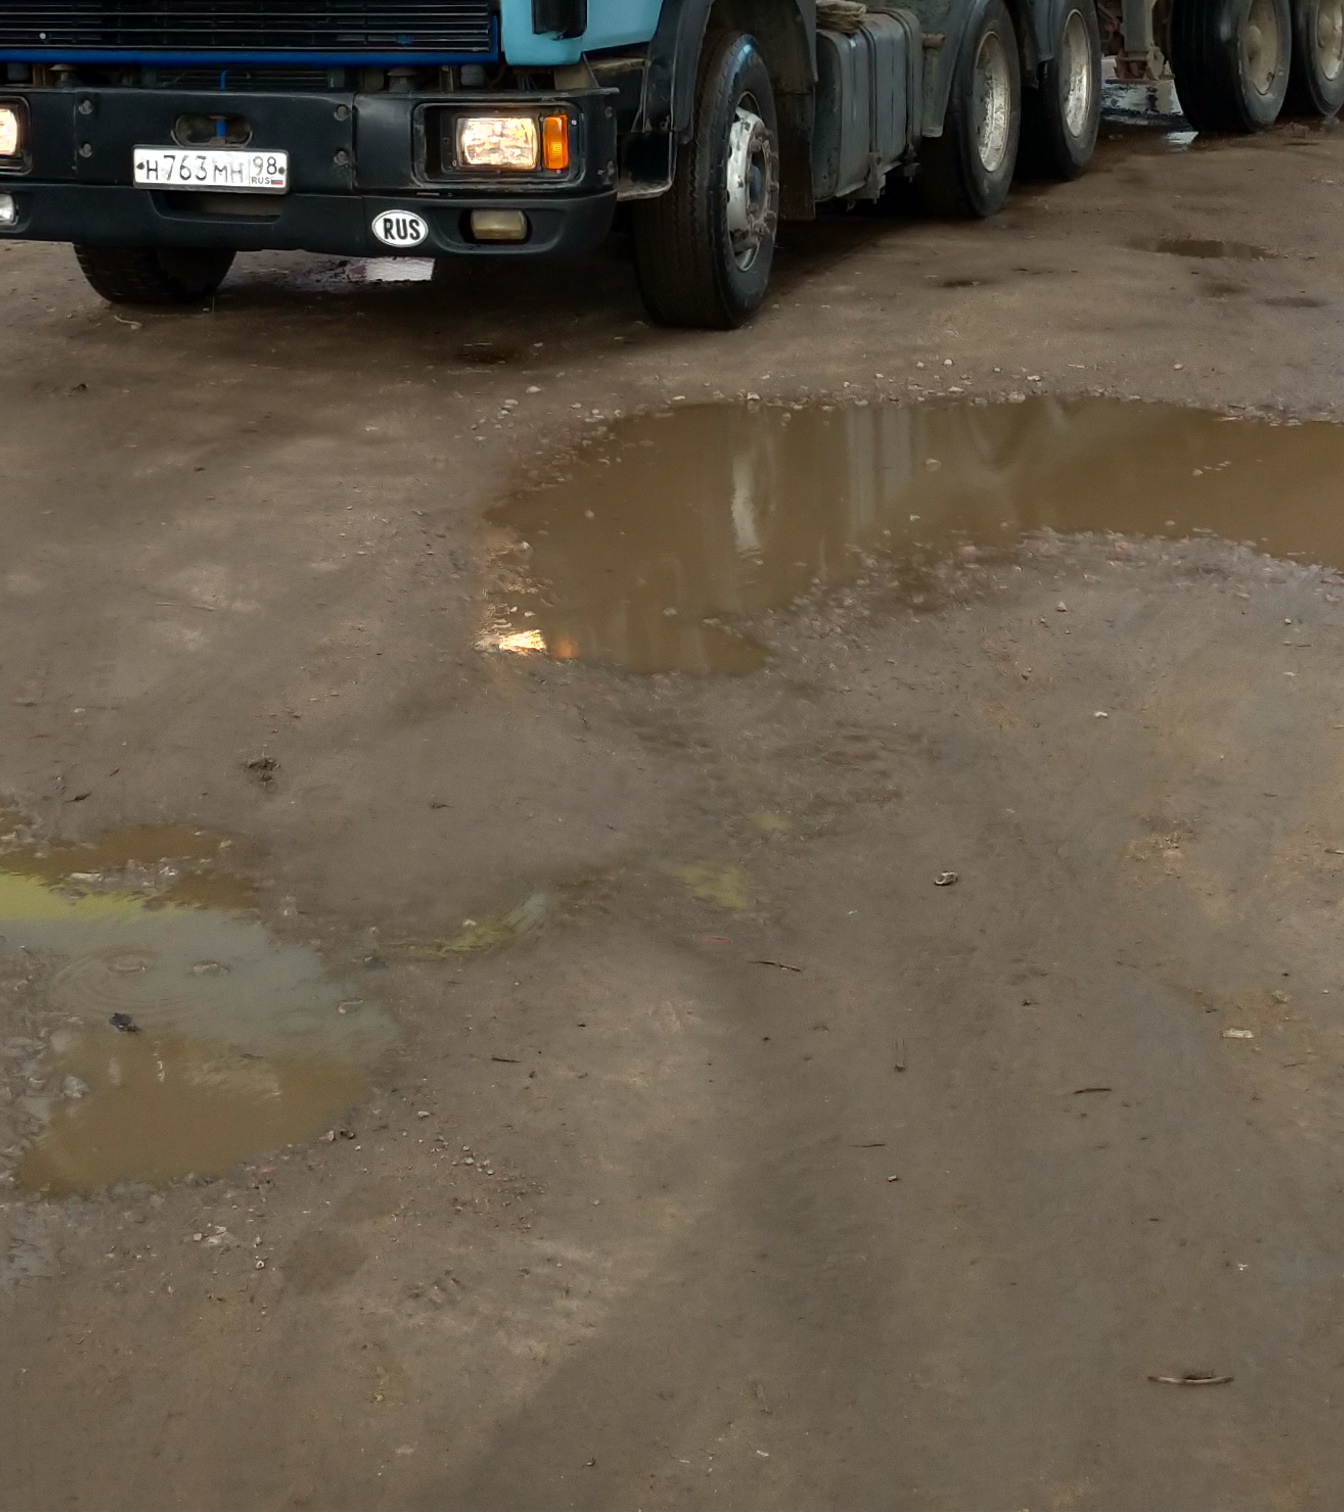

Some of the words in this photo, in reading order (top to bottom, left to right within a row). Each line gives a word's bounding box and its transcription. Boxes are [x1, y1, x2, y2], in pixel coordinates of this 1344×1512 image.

[252, 156, 277, 176] 98
[251, 176, 270, 185] RUS
[383, 218, 421, 240] RUS
